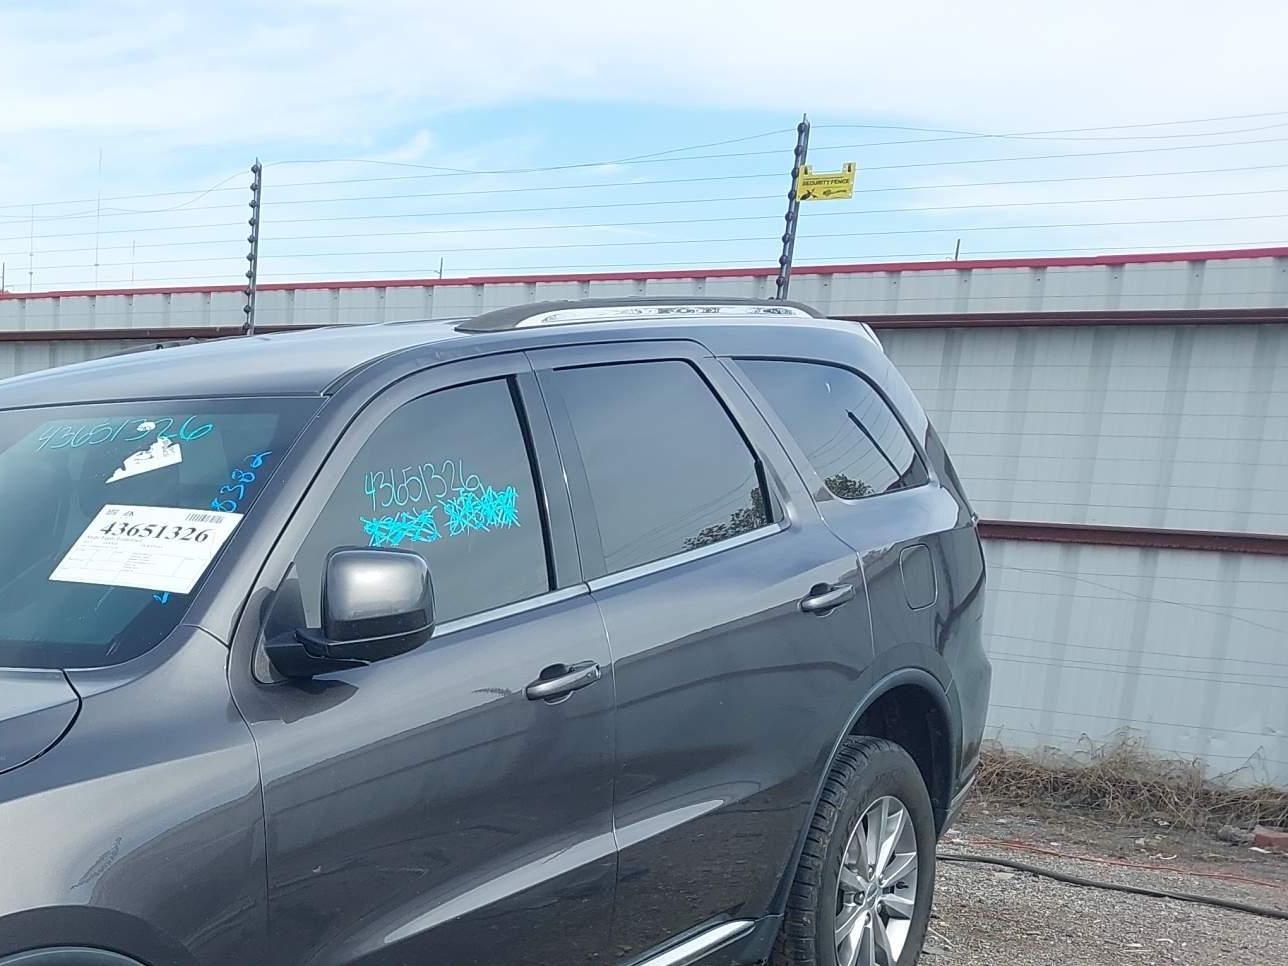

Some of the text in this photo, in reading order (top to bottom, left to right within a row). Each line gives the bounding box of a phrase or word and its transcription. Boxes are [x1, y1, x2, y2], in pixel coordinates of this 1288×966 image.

[38, 415, 213, 451] 43651326
[364, 459, 485, 511] 43651326
[100, 521, 214, 544] 43651326
